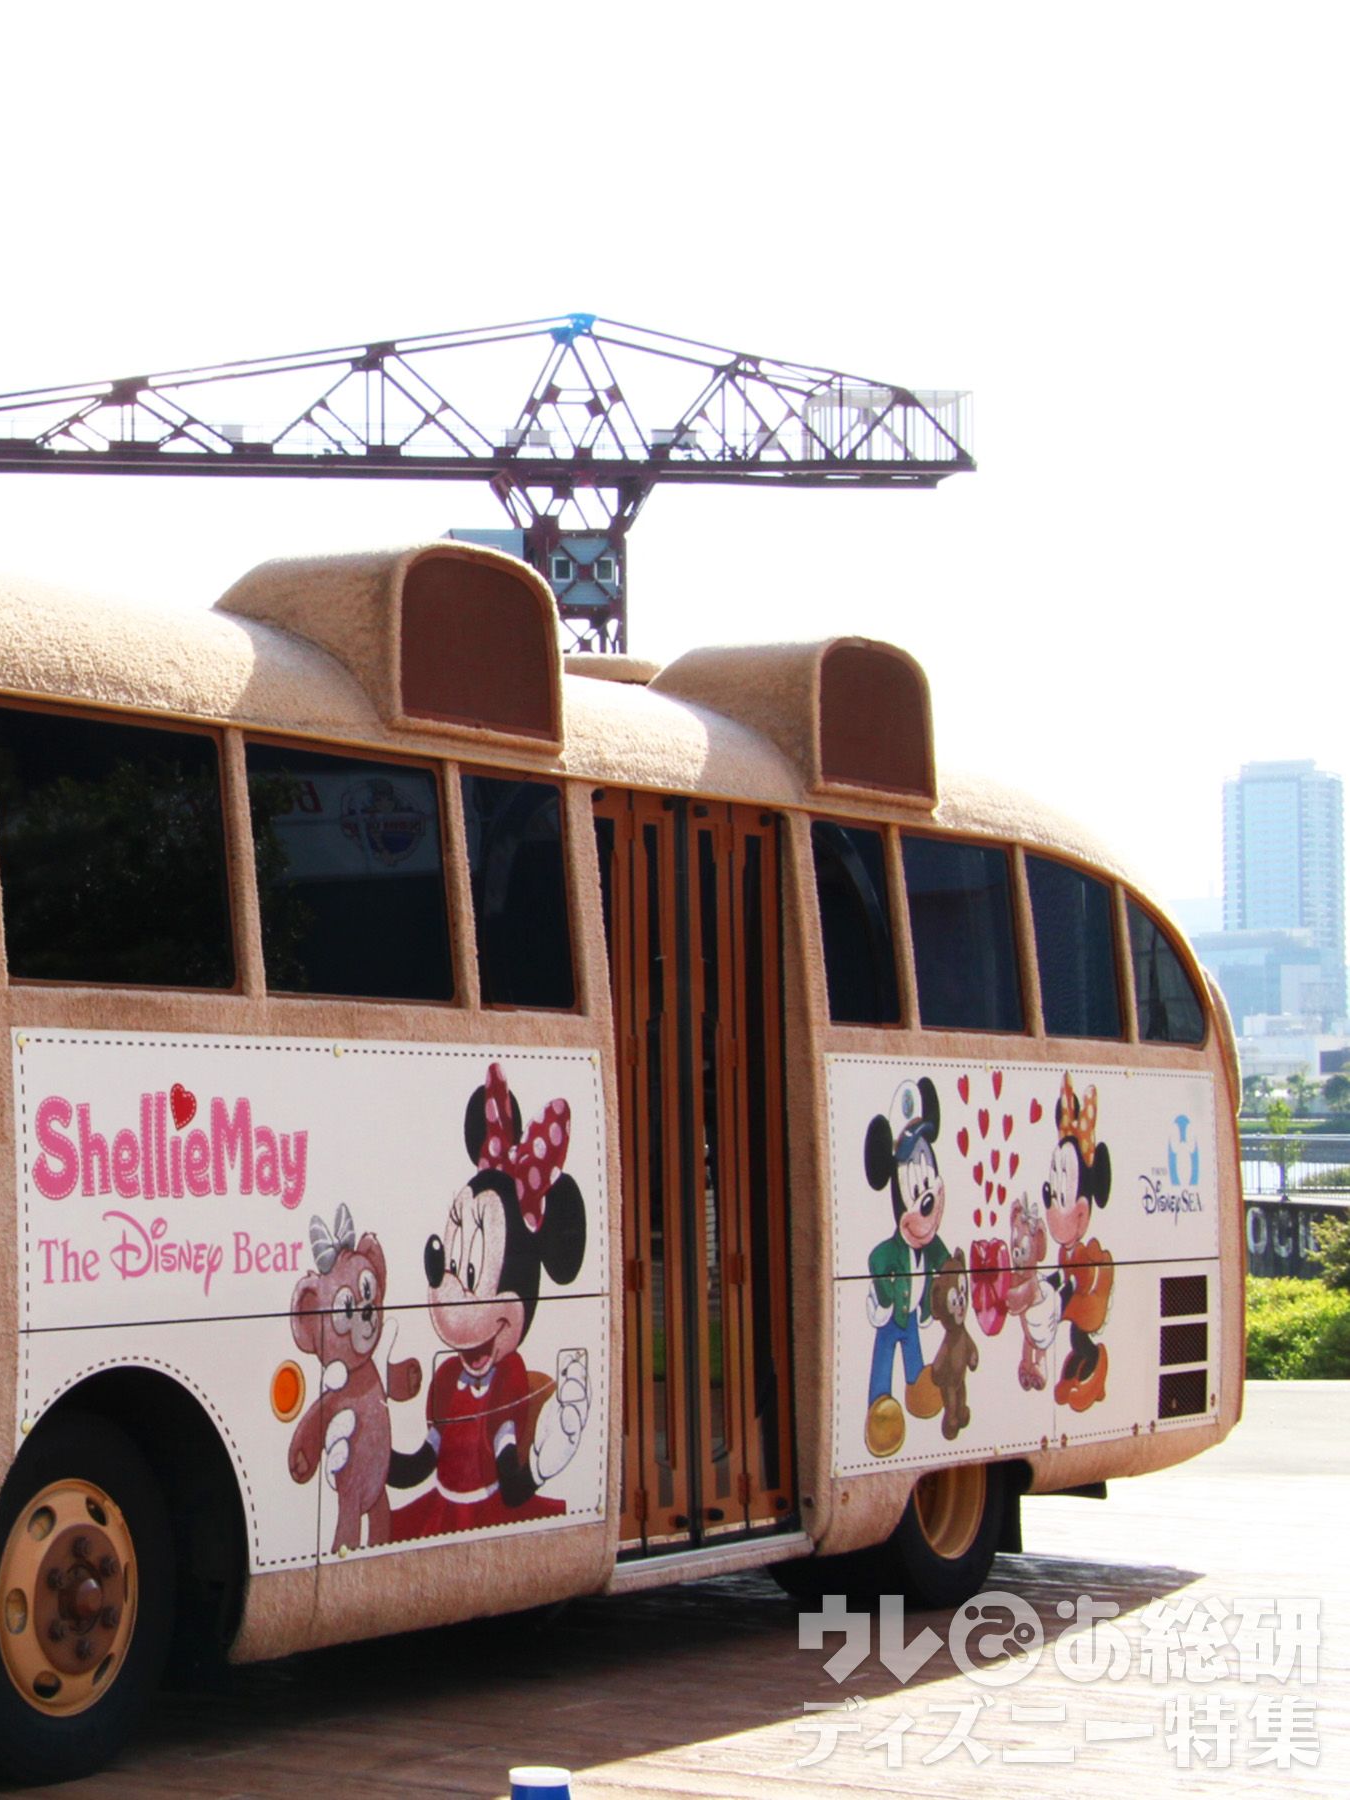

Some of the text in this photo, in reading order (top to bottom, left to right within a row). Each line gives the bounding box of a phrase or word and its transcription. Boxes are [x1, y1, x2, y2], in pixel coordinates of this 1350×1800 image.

[32, 1083, 308, 1210] ShellieMay
[38, 1238, 100, 1284] The
[232, 1231, 303, 1275] Bear
